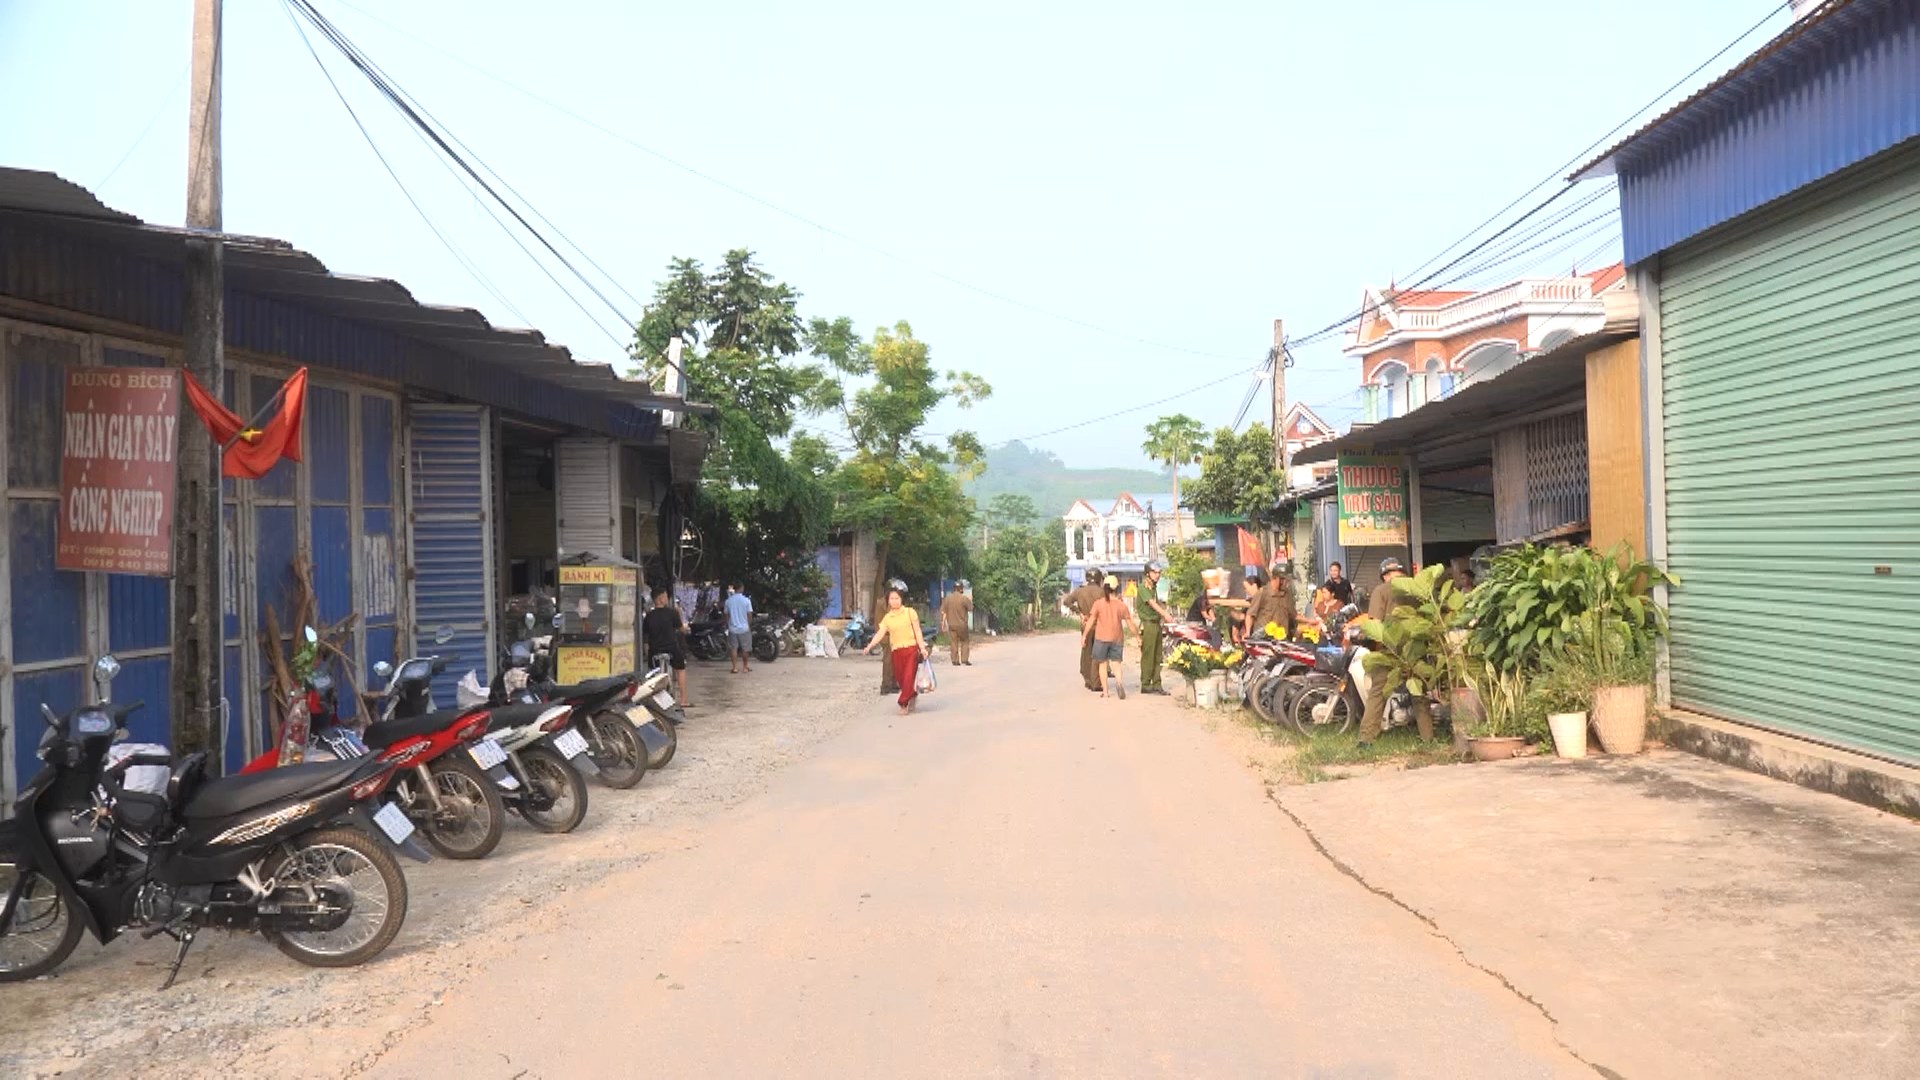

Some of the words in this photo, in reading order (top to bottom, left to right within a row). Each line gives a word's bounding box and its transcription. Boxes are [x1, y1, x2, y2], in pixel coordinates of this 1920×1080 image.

[127, 371, 173, 388] BÍCH
[64, 398, 106, 471] NHẬN
[107, 400, 144, 472] GIẶT
[1341, 461, 1401, 488] THUỐC
[69, 471, 108, 533] CÔNG
[109, 474, 164, 548] NGHIỆP
[1342, 490, 1371, 513] TRỪ
[1374, 489, 1402, 512] SÂU
